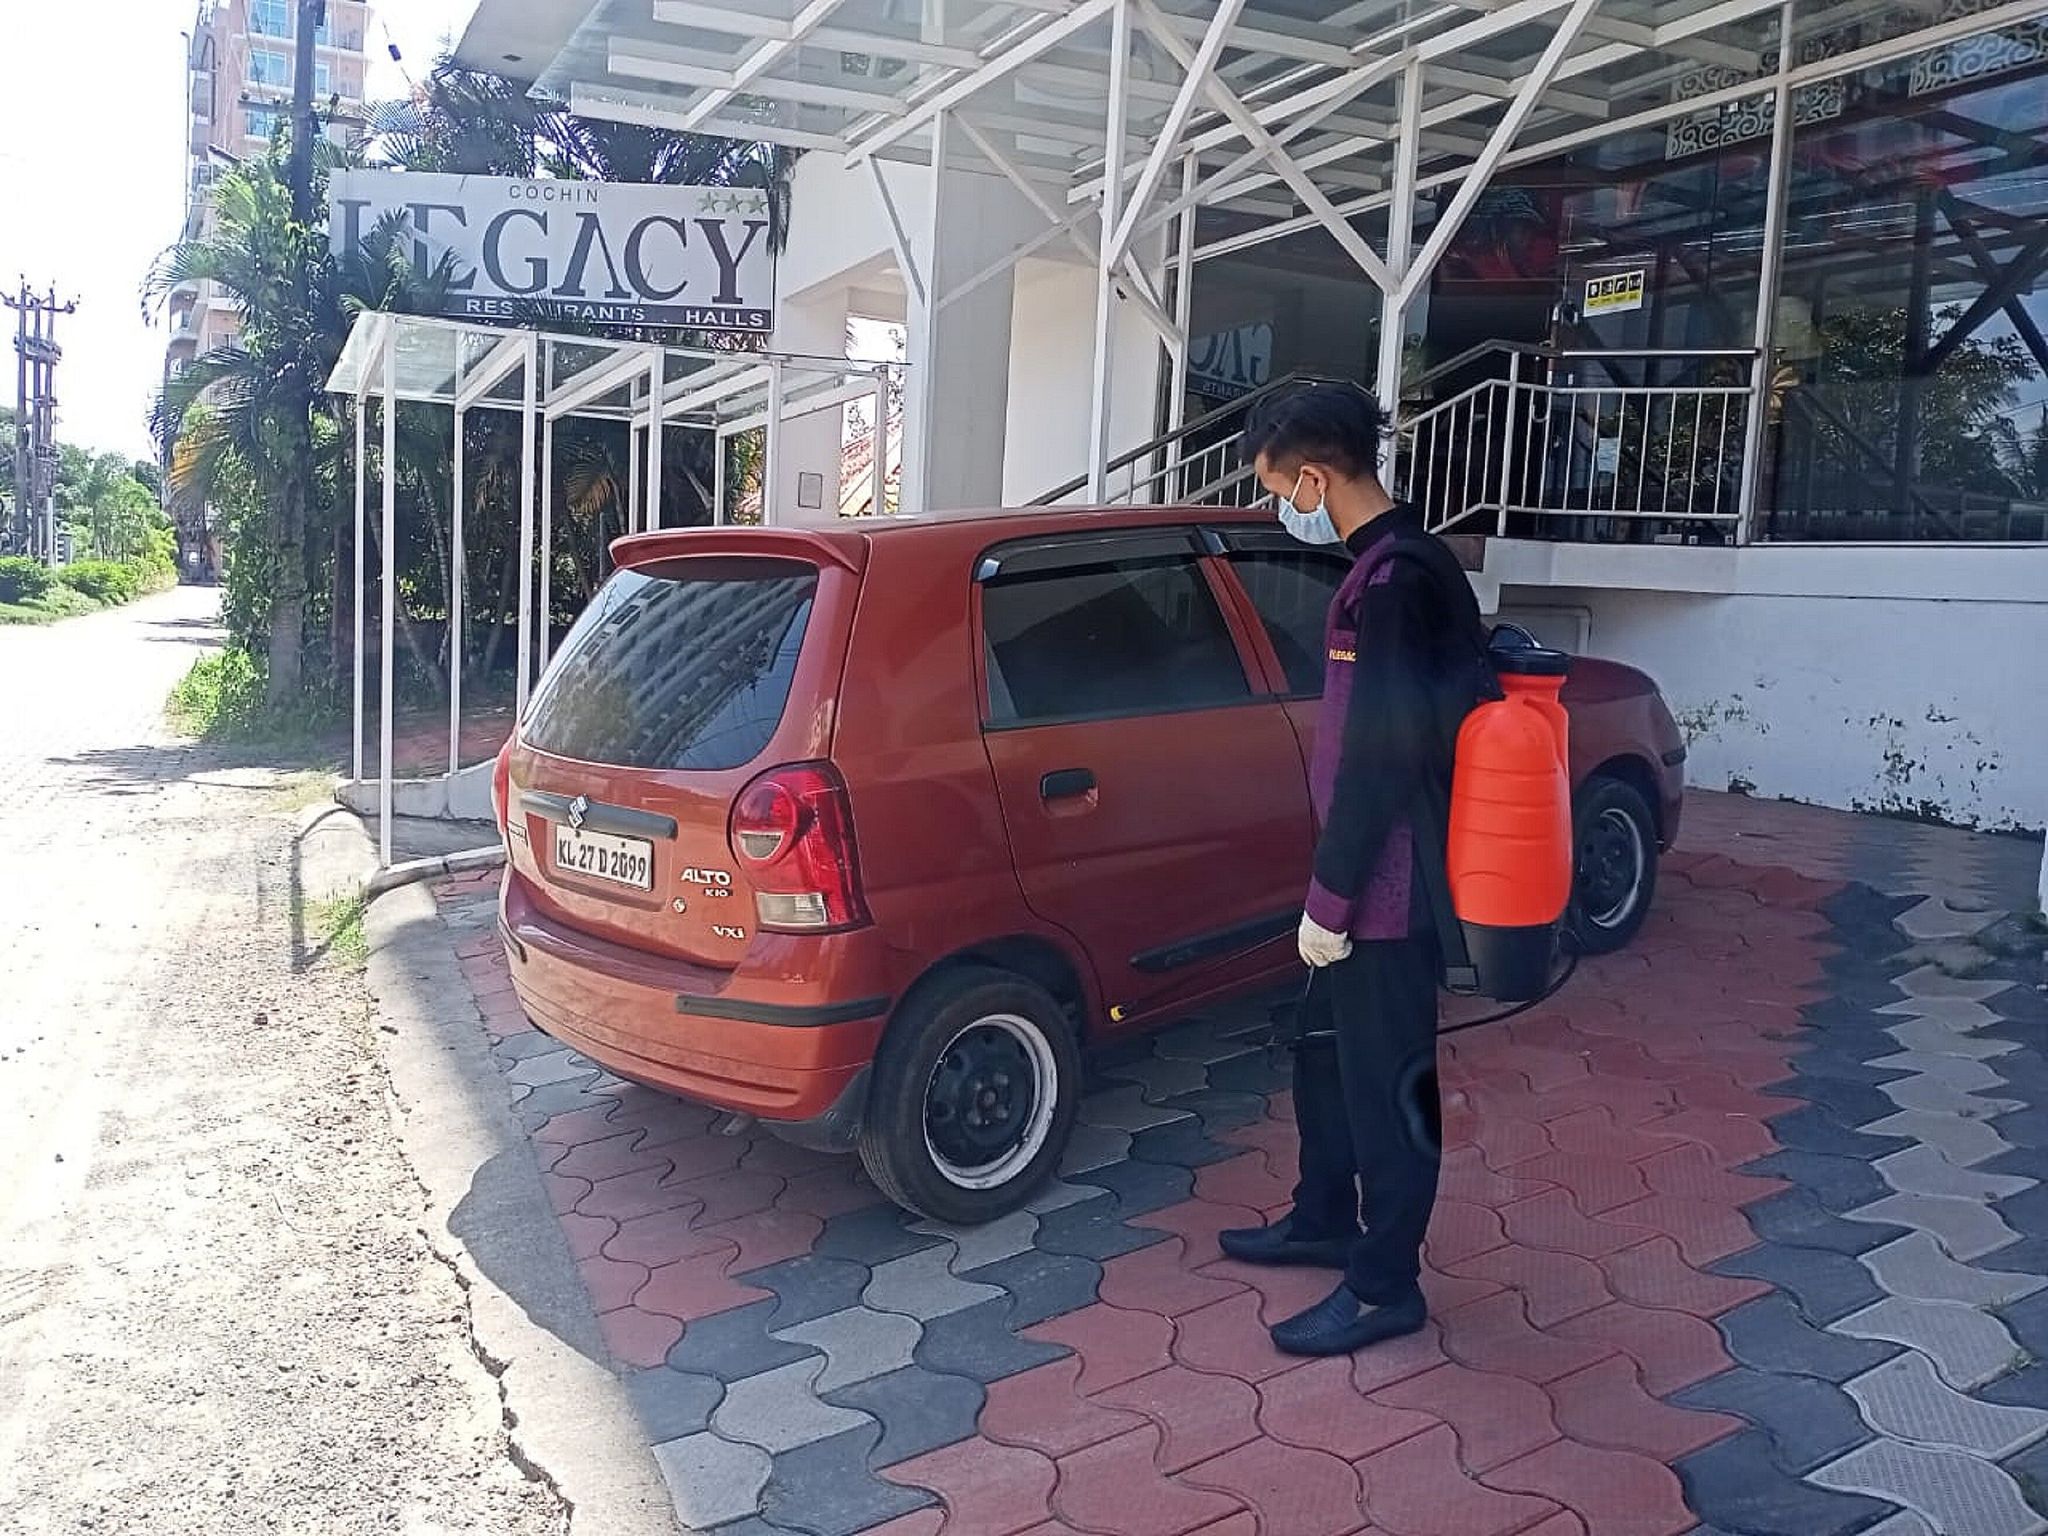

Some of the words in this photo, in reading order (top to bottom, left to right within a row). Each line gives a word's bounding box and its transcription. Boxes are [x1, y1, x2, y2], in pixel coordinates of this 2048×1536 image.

[509, 184, 598, 203] COCHIN
[685, 309, 765, 327] HALLS
[558, 838, 577, 867] KL
[578, 843, 596, 872] 27
[598, 847, 609, 874] D
[610, 850, 647, 883] 2099
[680, 867, 732, 887] ALTO
[704, 888, 730, 898] K10
